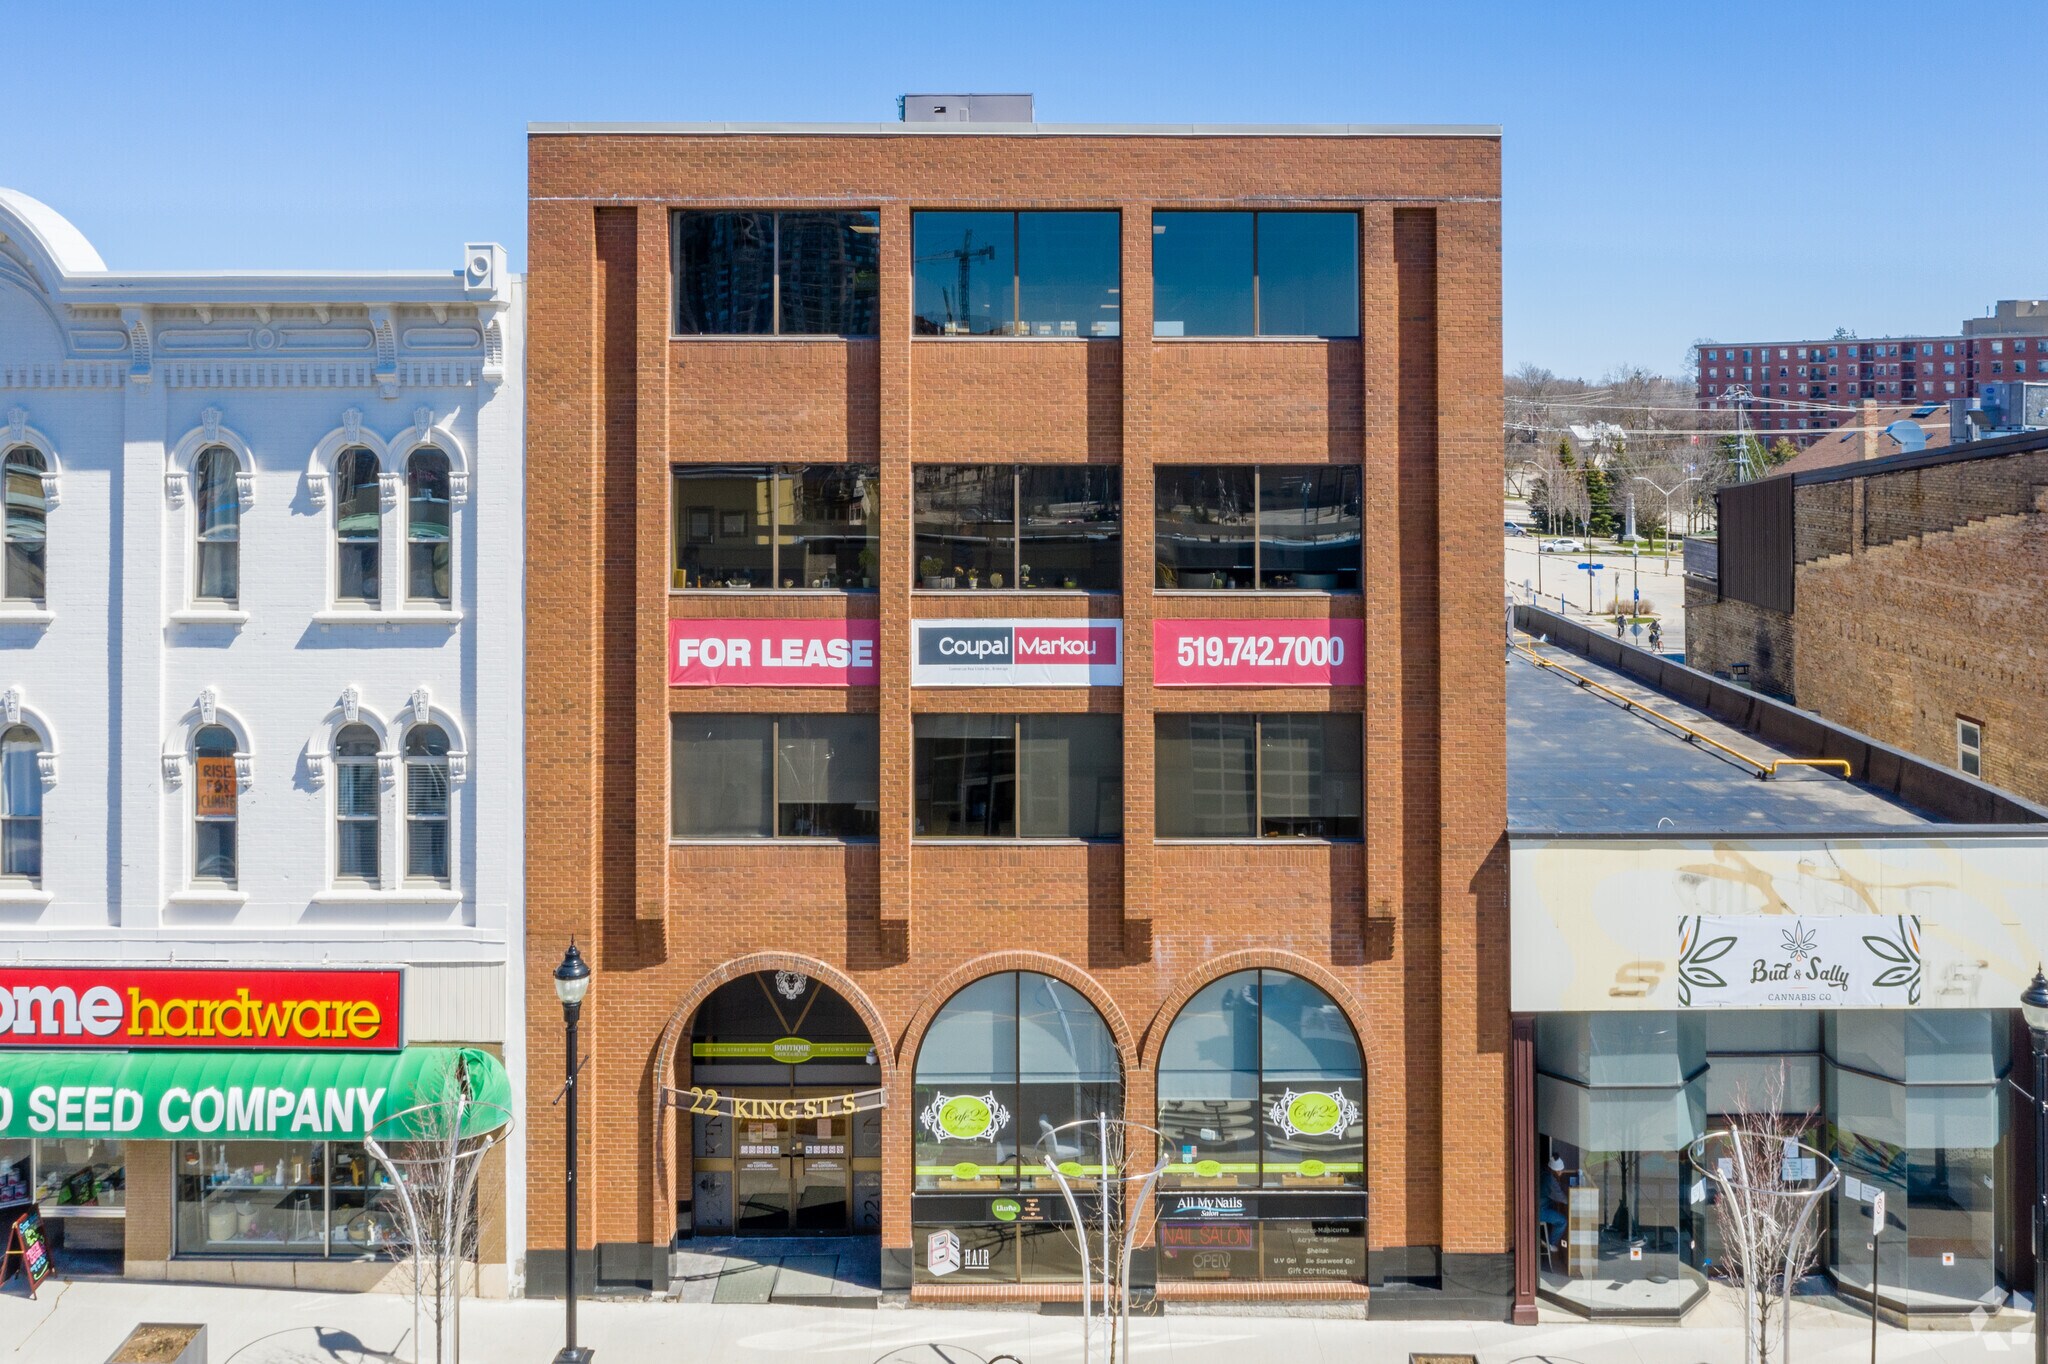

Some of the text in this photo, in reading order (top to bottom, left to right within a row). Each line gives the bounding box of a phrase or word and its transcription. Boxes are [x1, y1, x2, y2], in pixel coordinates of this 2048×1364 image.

[679, 638, 873, 667] FOR LEASE
[939, 636, 1096, 659] Coupal Markou
[1177, 636, 1344, 667] 519.742.7000
[203, 765, 232, 779] RISE
[206, 780, 230, 793] FOR
[201, 795, 236, 809] CLIMATE
[1750, 956, 1849, 991] Bud & Sally
[1768, 993, 1832, 1001] CANNABIS CO
[127, 987, 381, 1039] hardware
[774, 1044, 811, 1053] BOUTIQUE
[28, 1085, 143, 1132] SEED
[159, 1085, 386, 1132] COMPANY
[690, 1087, 861, 1119] 22 KING ST. S.
[970, 1108, 989, 1121] 22
[1319, 1105, 1338, 1118] 22
[1177, 1197, 1243, 1211] All My Nails
[1164, 1226, 1250, 1245] NAIL SALON
[965, 1249, 989, 1265] HAIR
[1193, 1252, 1231, 1268] OPEN
[1303, 1267, 1348, 1275] Certificates
